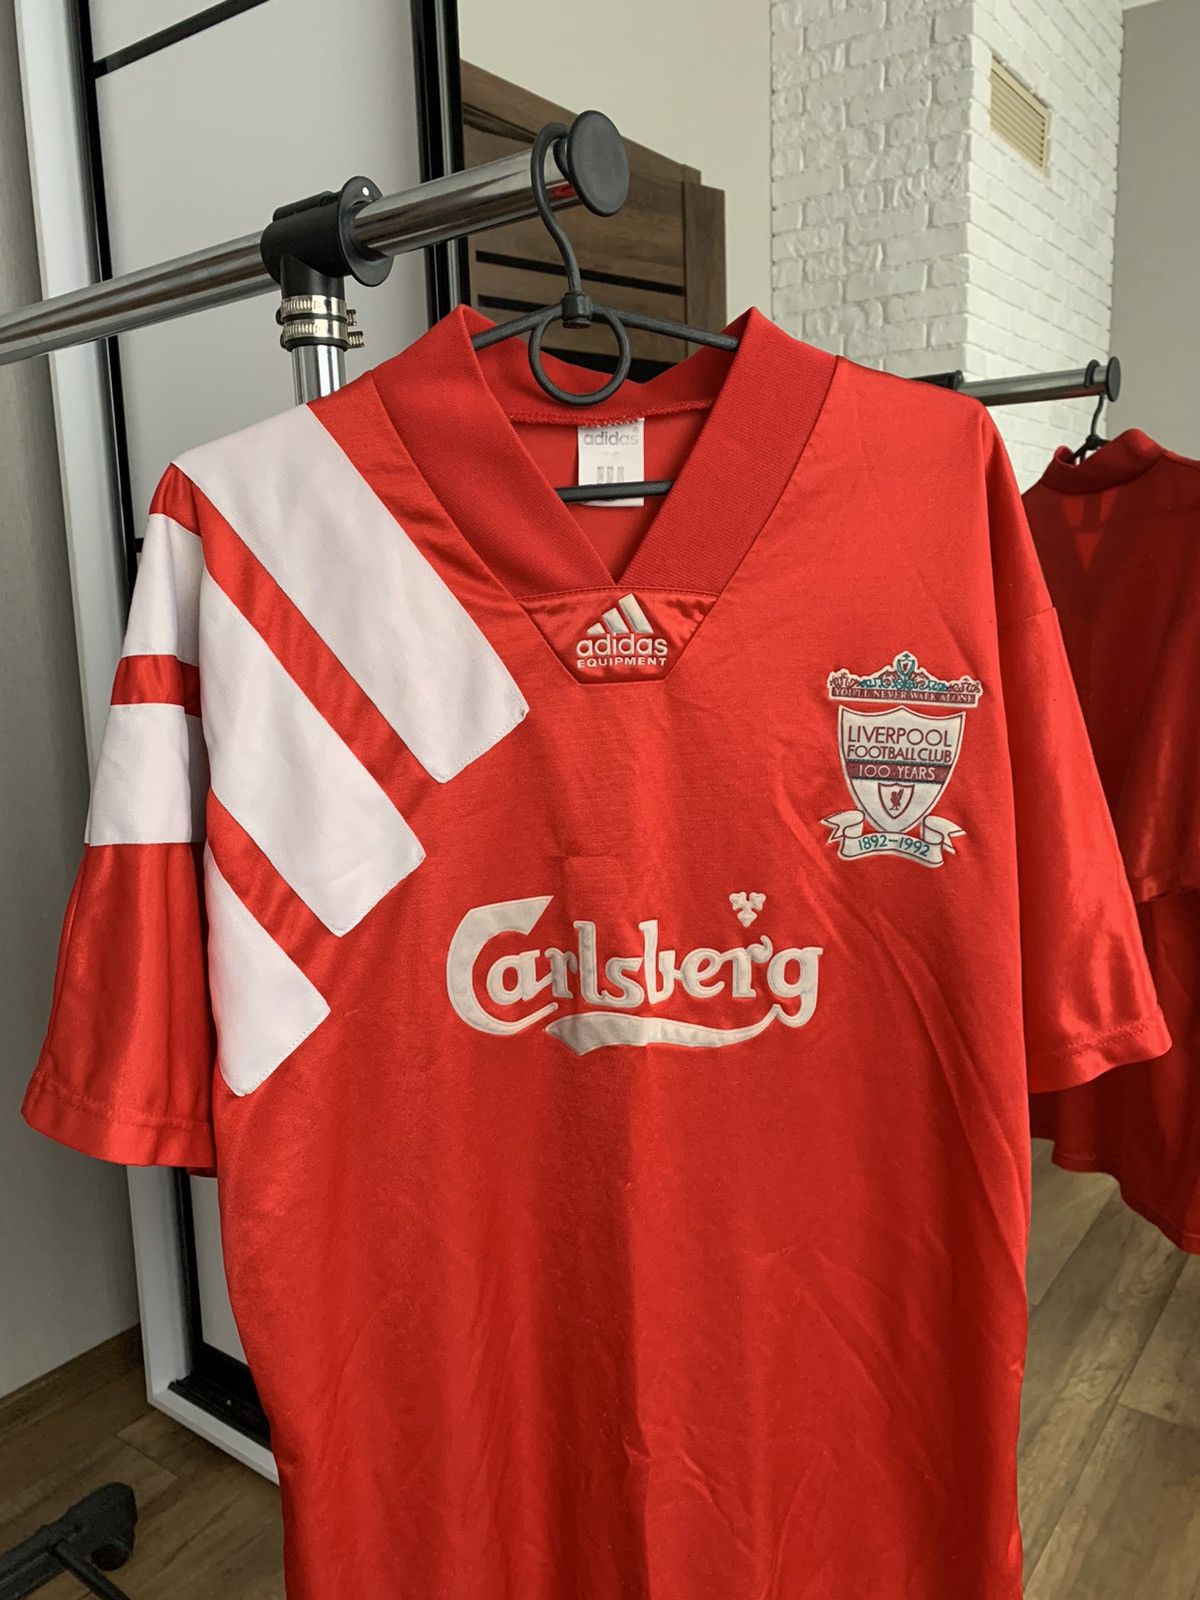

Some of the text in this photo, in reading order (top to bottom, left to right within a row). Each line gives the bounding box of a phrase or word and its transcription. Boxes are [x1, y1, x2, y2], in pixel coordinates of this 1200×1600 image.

[584, 431, 639, 446] adidas
[576, 633, 668, 657] adidas
[577, 657, 667, 669] EQUIPMENT
[847, 725, 952, 748] LIVERPOOL
[846, 744, 953, 763] FOOTBALL CLUB
[859, 764, 936, 781] 100 YEARS
[446, 895, 824, 1036] Carlsberg
